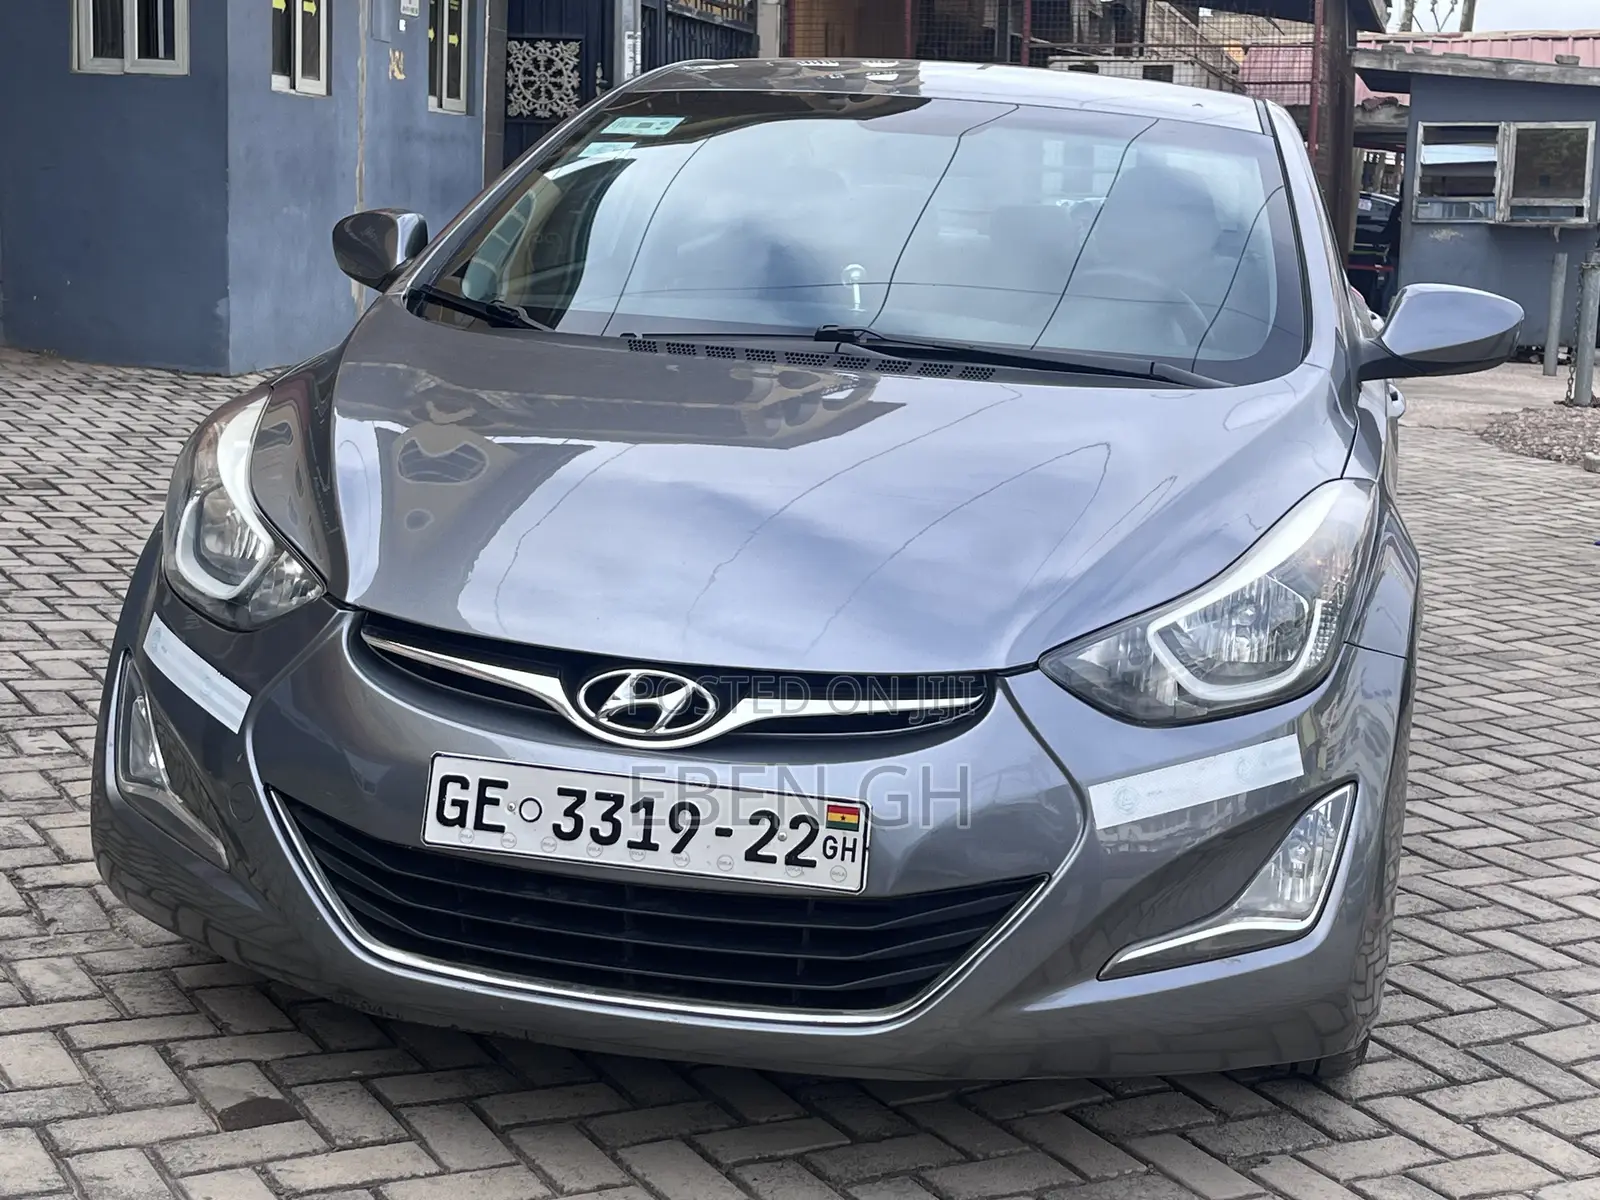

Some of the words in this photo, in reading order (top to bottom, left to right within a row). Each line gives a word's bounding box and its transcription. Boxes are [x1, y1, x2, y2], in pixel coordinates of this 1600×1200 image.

[436, 774, 509, 833] GE
[552, 787, 820, 868] 3319-22
[822, 835, 857, 863] GH
